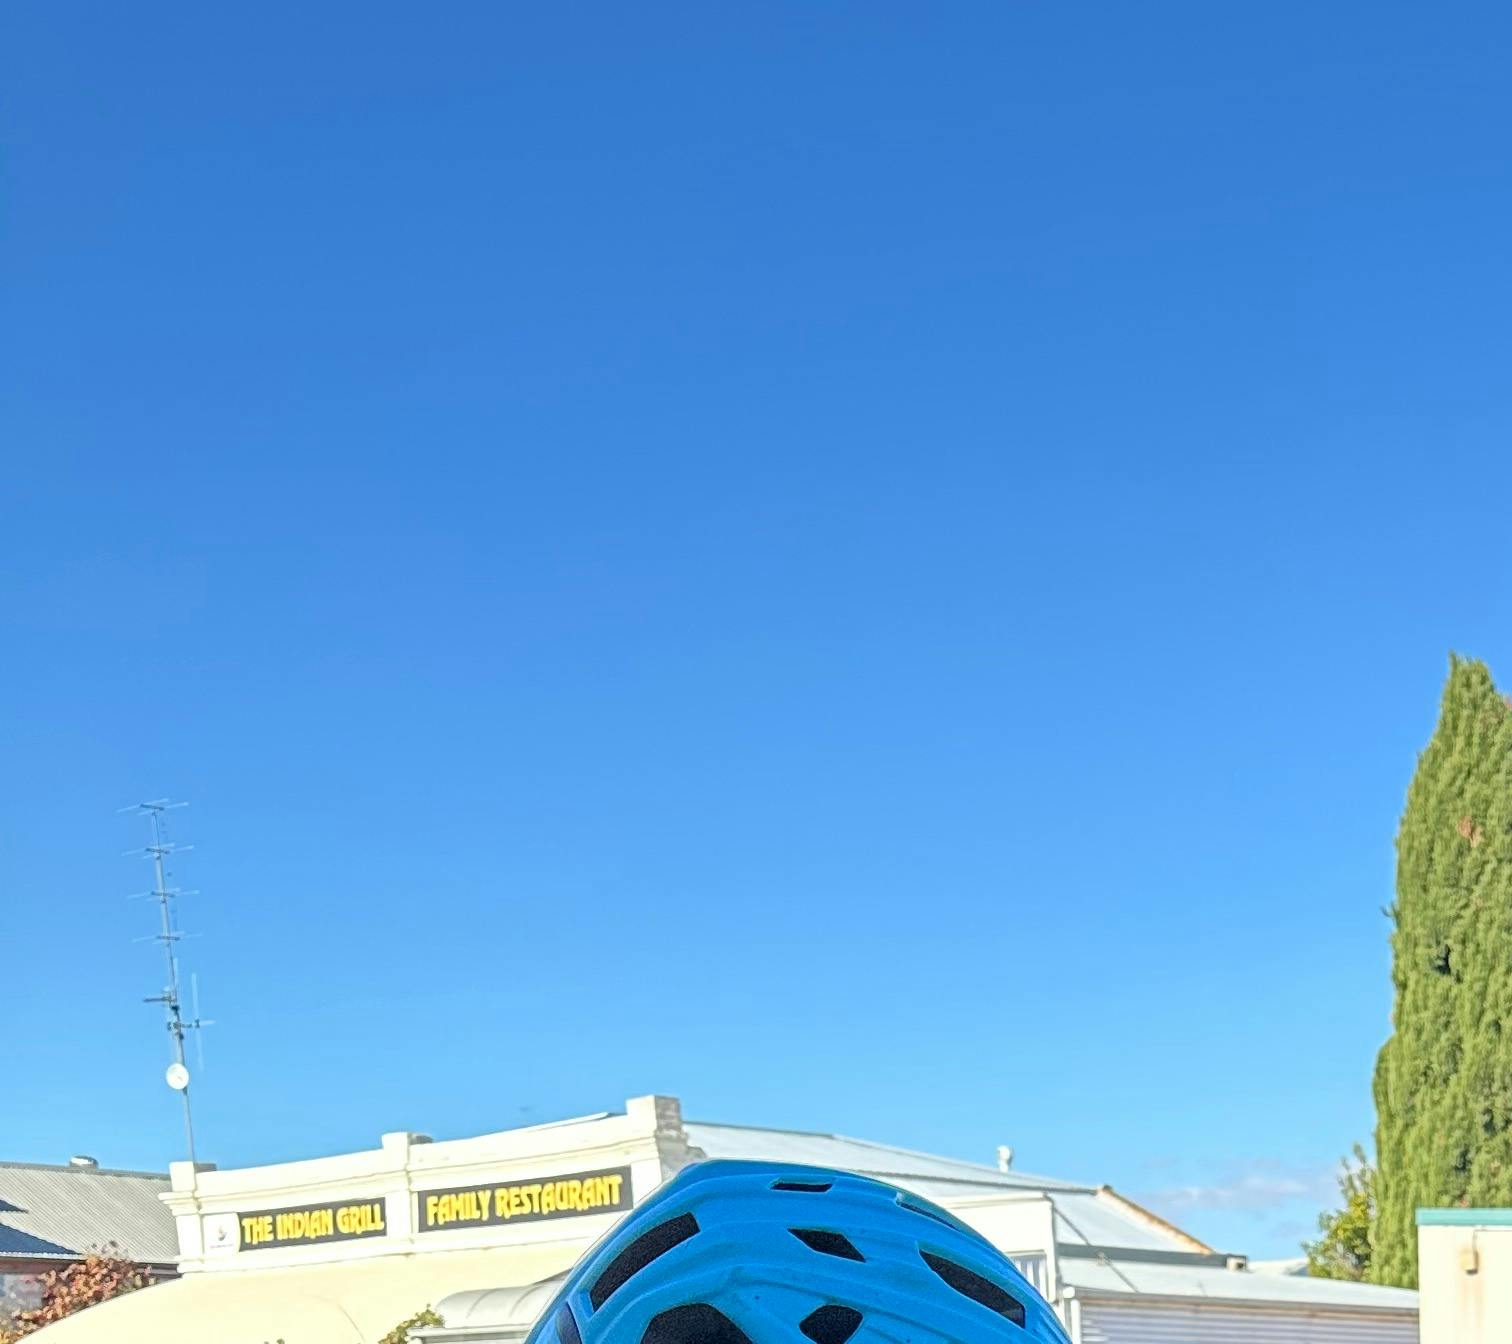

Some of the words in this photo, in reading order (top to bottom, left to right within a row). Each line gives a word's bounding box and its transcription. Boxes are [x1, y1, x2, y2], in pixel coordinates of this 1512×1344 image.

[426, 1190, 491, 1226] FAMILY
[494, 1174, 623, 1220] RESTAURANT
[242, 1217, 274, 1246] THE
[276, 1208, 334, 1241] INDIAN
[336, 1204, 385, 1234] GRILL
